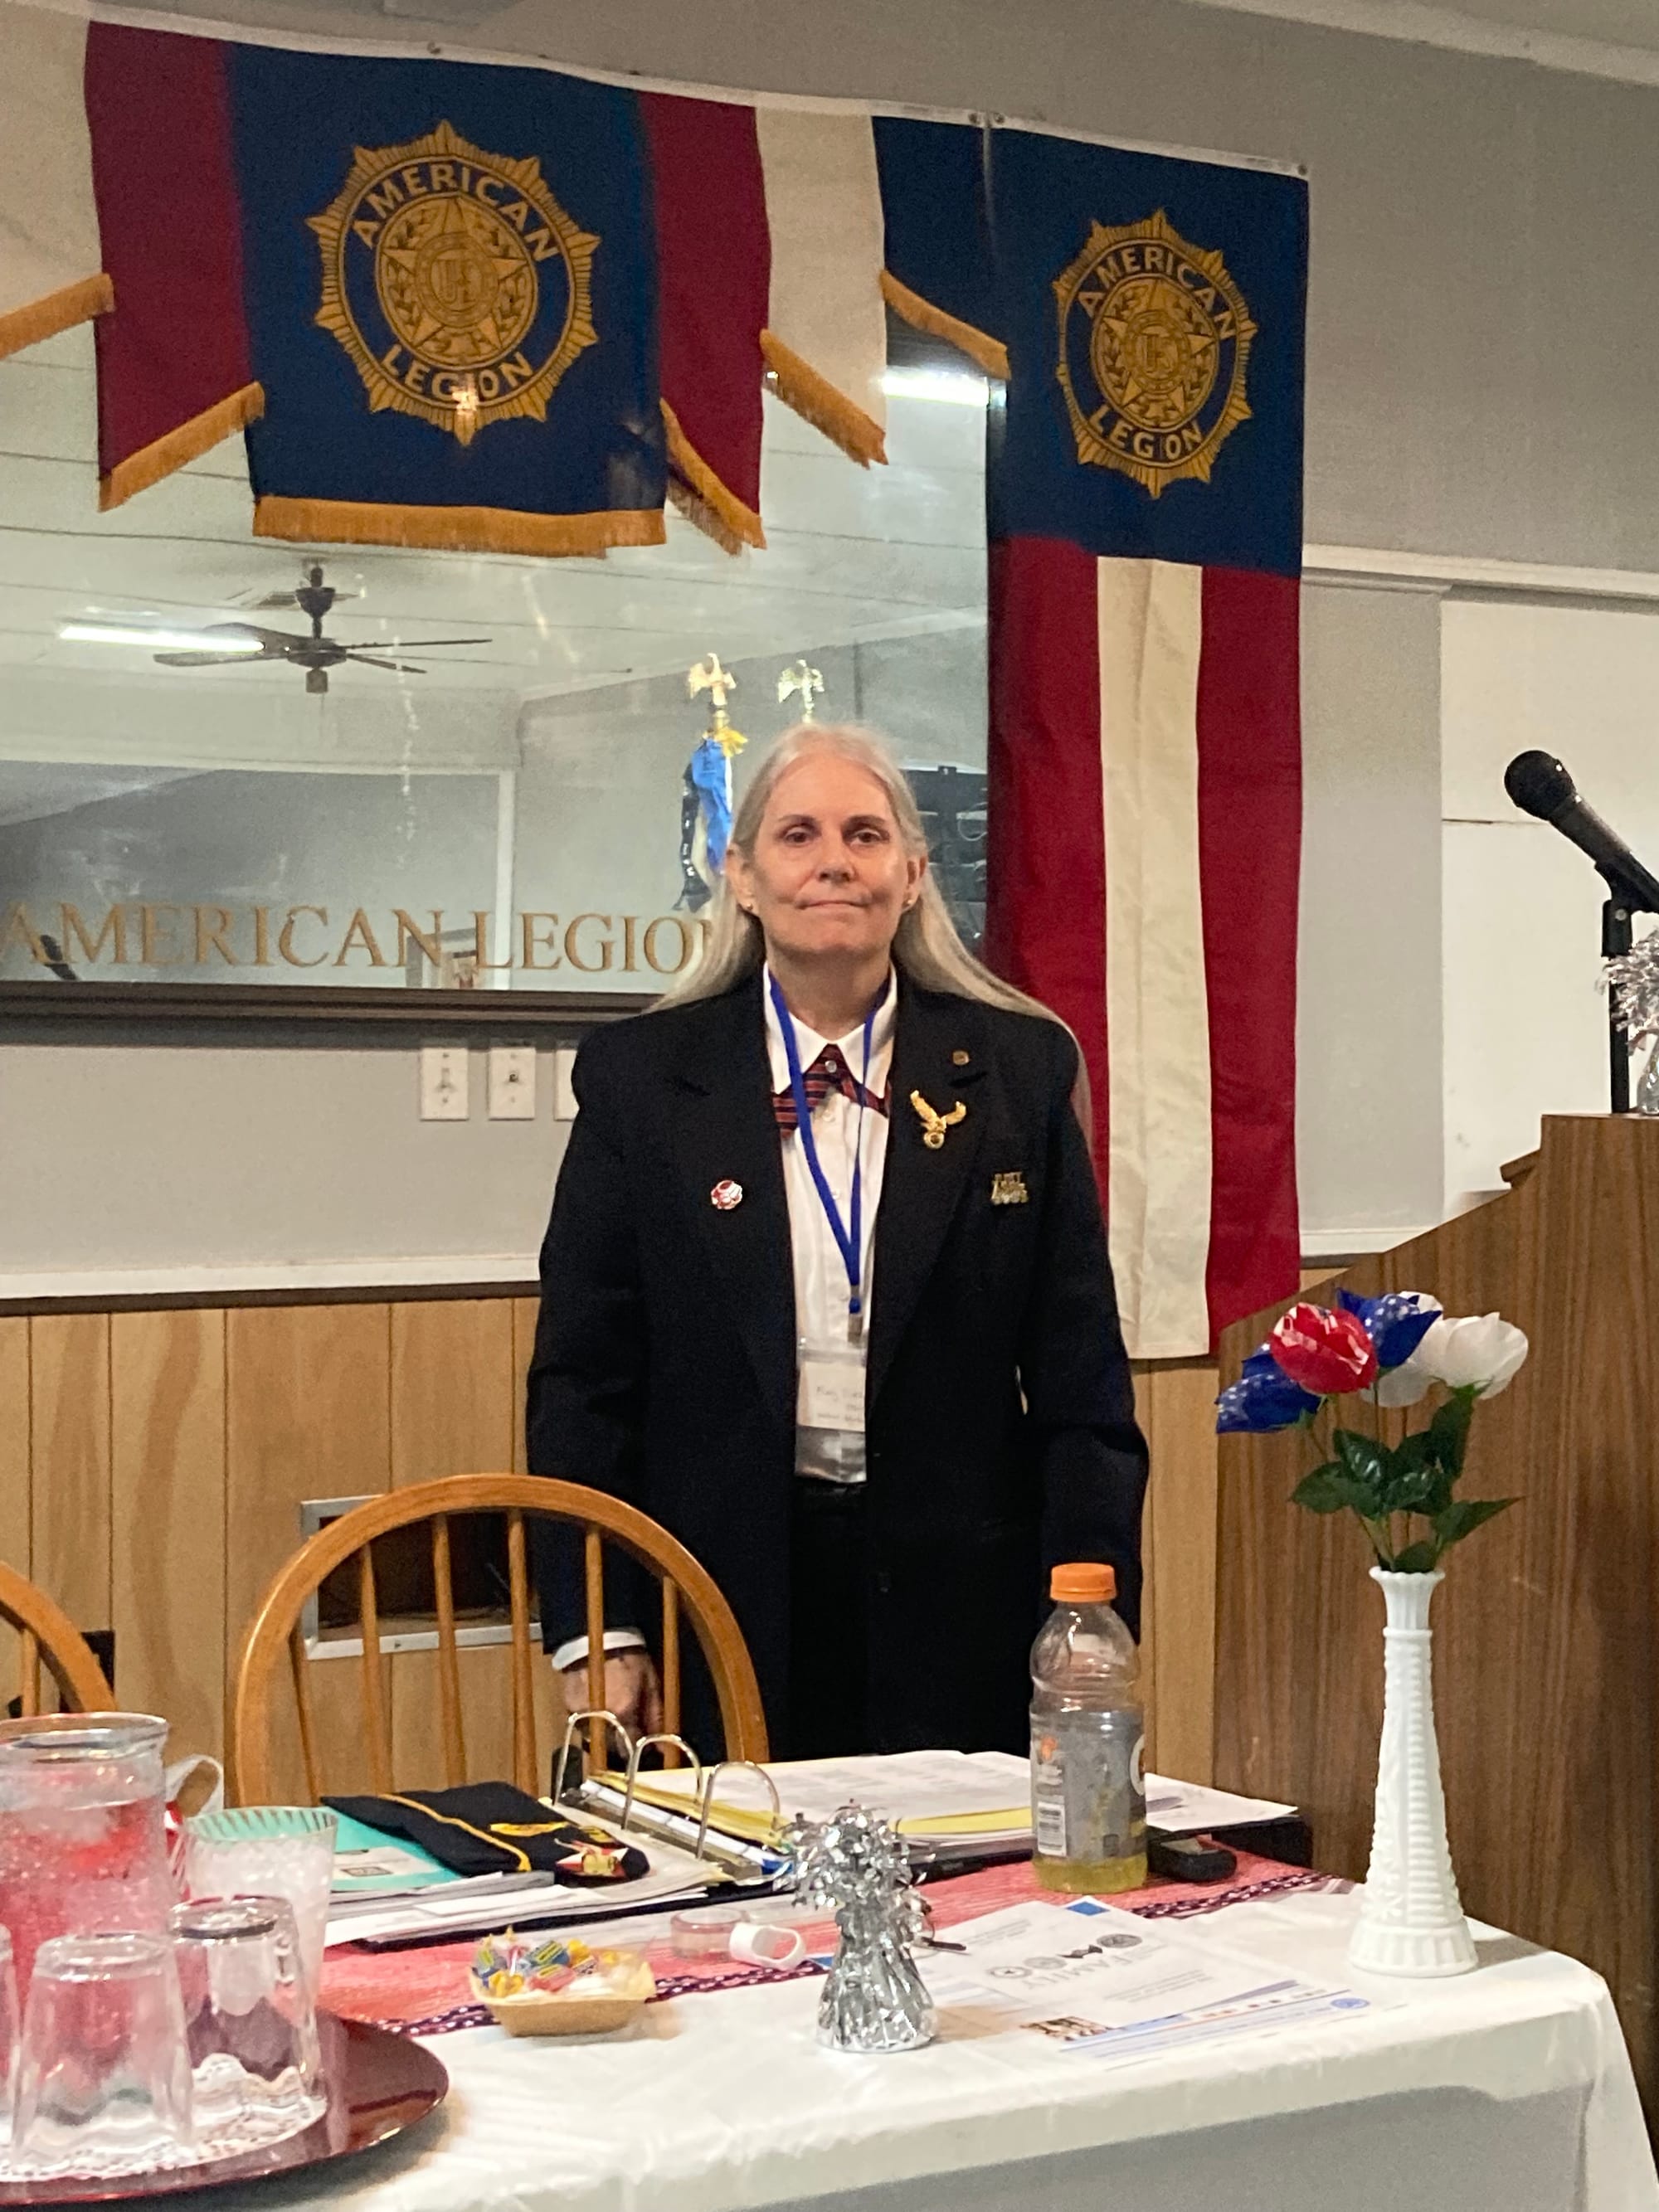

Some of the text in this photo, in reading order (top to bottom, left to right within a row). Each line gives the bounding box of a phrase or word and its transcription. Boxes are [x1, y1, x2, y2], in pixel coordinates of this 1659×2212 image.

[352, 163, 560, 262] AMERICAN
[1078, 246, 1237, 341] AMERICAN
[381, 343, 533, 402] LEGION
[1088, 404, 1203, 460] LEGON
[0, 901, 445, 969] AMERICAN
